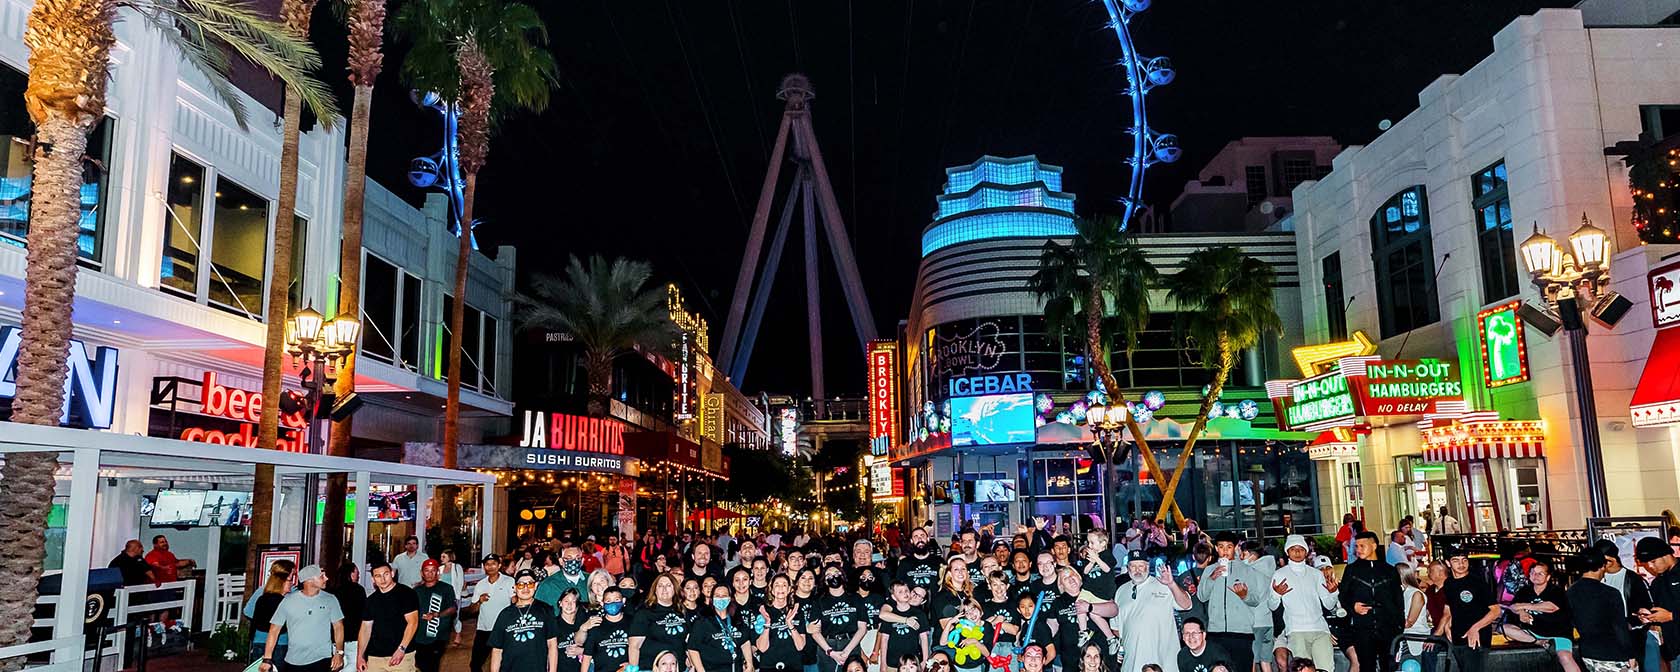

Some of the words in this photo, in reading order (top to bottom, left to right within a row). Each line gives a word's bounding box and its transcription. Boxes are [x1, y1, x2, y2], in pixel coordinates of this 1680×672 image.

[1367, 363, 1451, 379] IN-N-OUT
[949, 374, 1032, 396] ICEBAR
[1293, 374, 1346, 403] IN-N-OUT
[1369, 381, 1462, 398] HAMBURGERS
[202, 371, 262, 421] bee
[1377, 404, 1393, 413] NO
[1396, 402, 1428, 413] DELAY
[520, 410, 546, 448] JA
[551, 412, 625, 455] BURRITOS
[526, 453, 570, 465] SUSHI
[575, 456, 621, 469] BURRITOS
